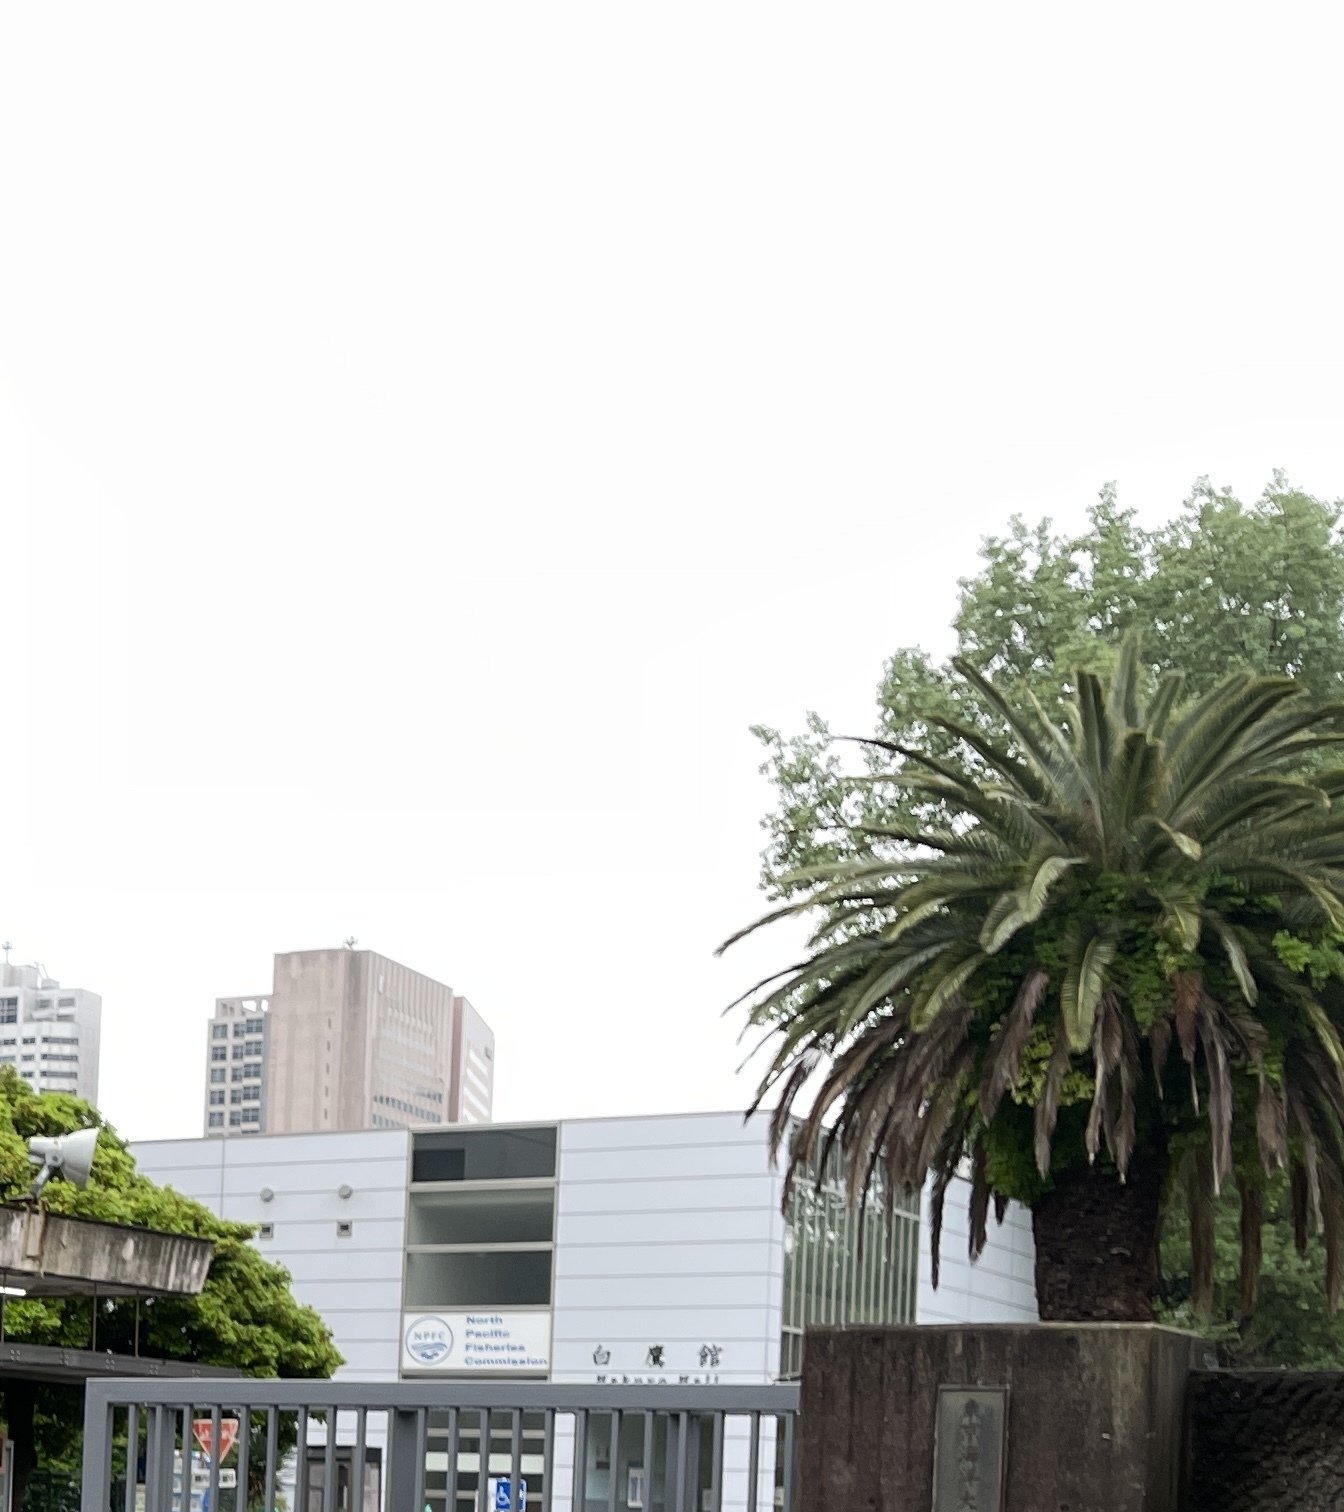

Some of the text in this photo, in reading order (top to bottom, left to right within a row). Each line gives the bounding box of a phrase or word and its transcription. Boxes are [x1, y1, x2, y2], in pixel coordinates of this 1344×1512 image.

[466, 1315, 503, 1325] North
[465, 1329, 510, 1339] Pacific
[465, 1343, 525, 1352] Fisheries
[464, 1356, 548, 1366] Commission
